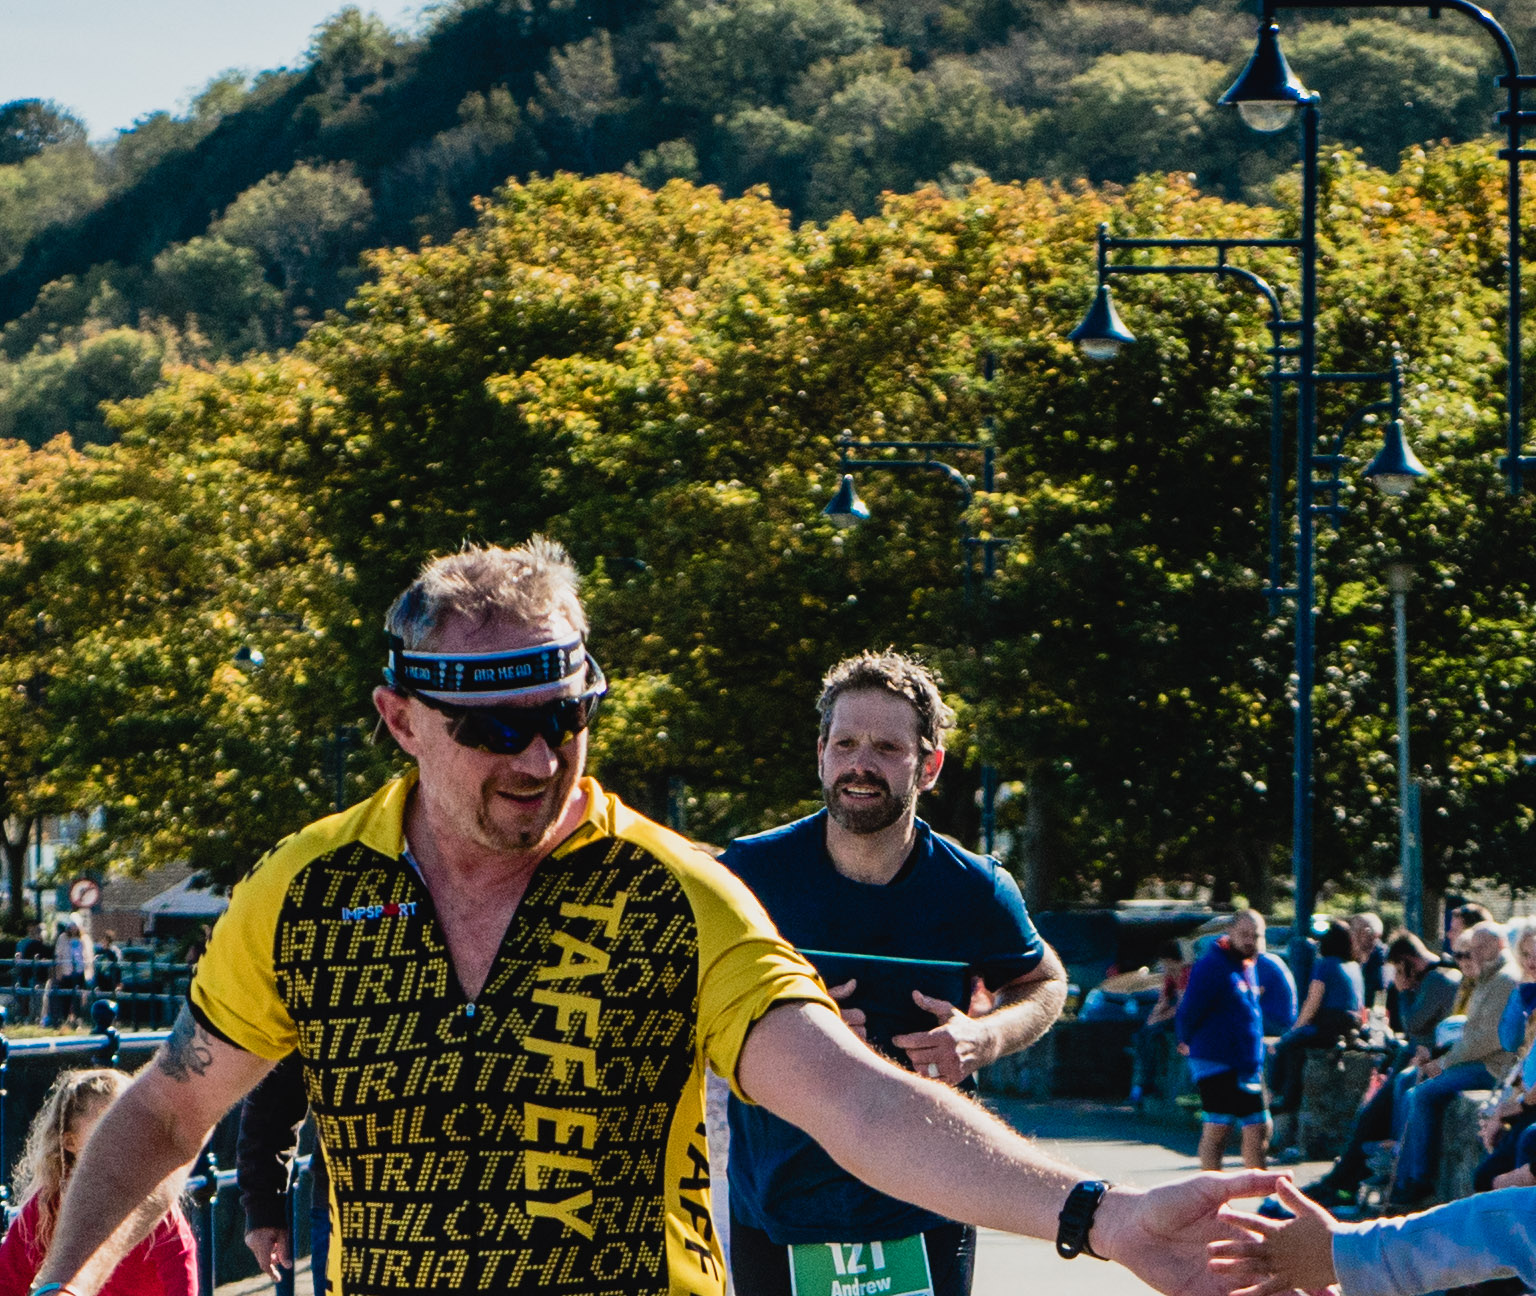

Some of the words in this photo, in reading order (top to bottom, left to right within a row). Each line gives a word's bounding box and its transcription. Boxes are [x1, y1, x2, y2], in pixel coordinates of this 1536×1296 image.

[473, 667, 496, 682] AIR
[498, 663, 533, 680] HEAD
[825, 1240, 886, 1276] 121
